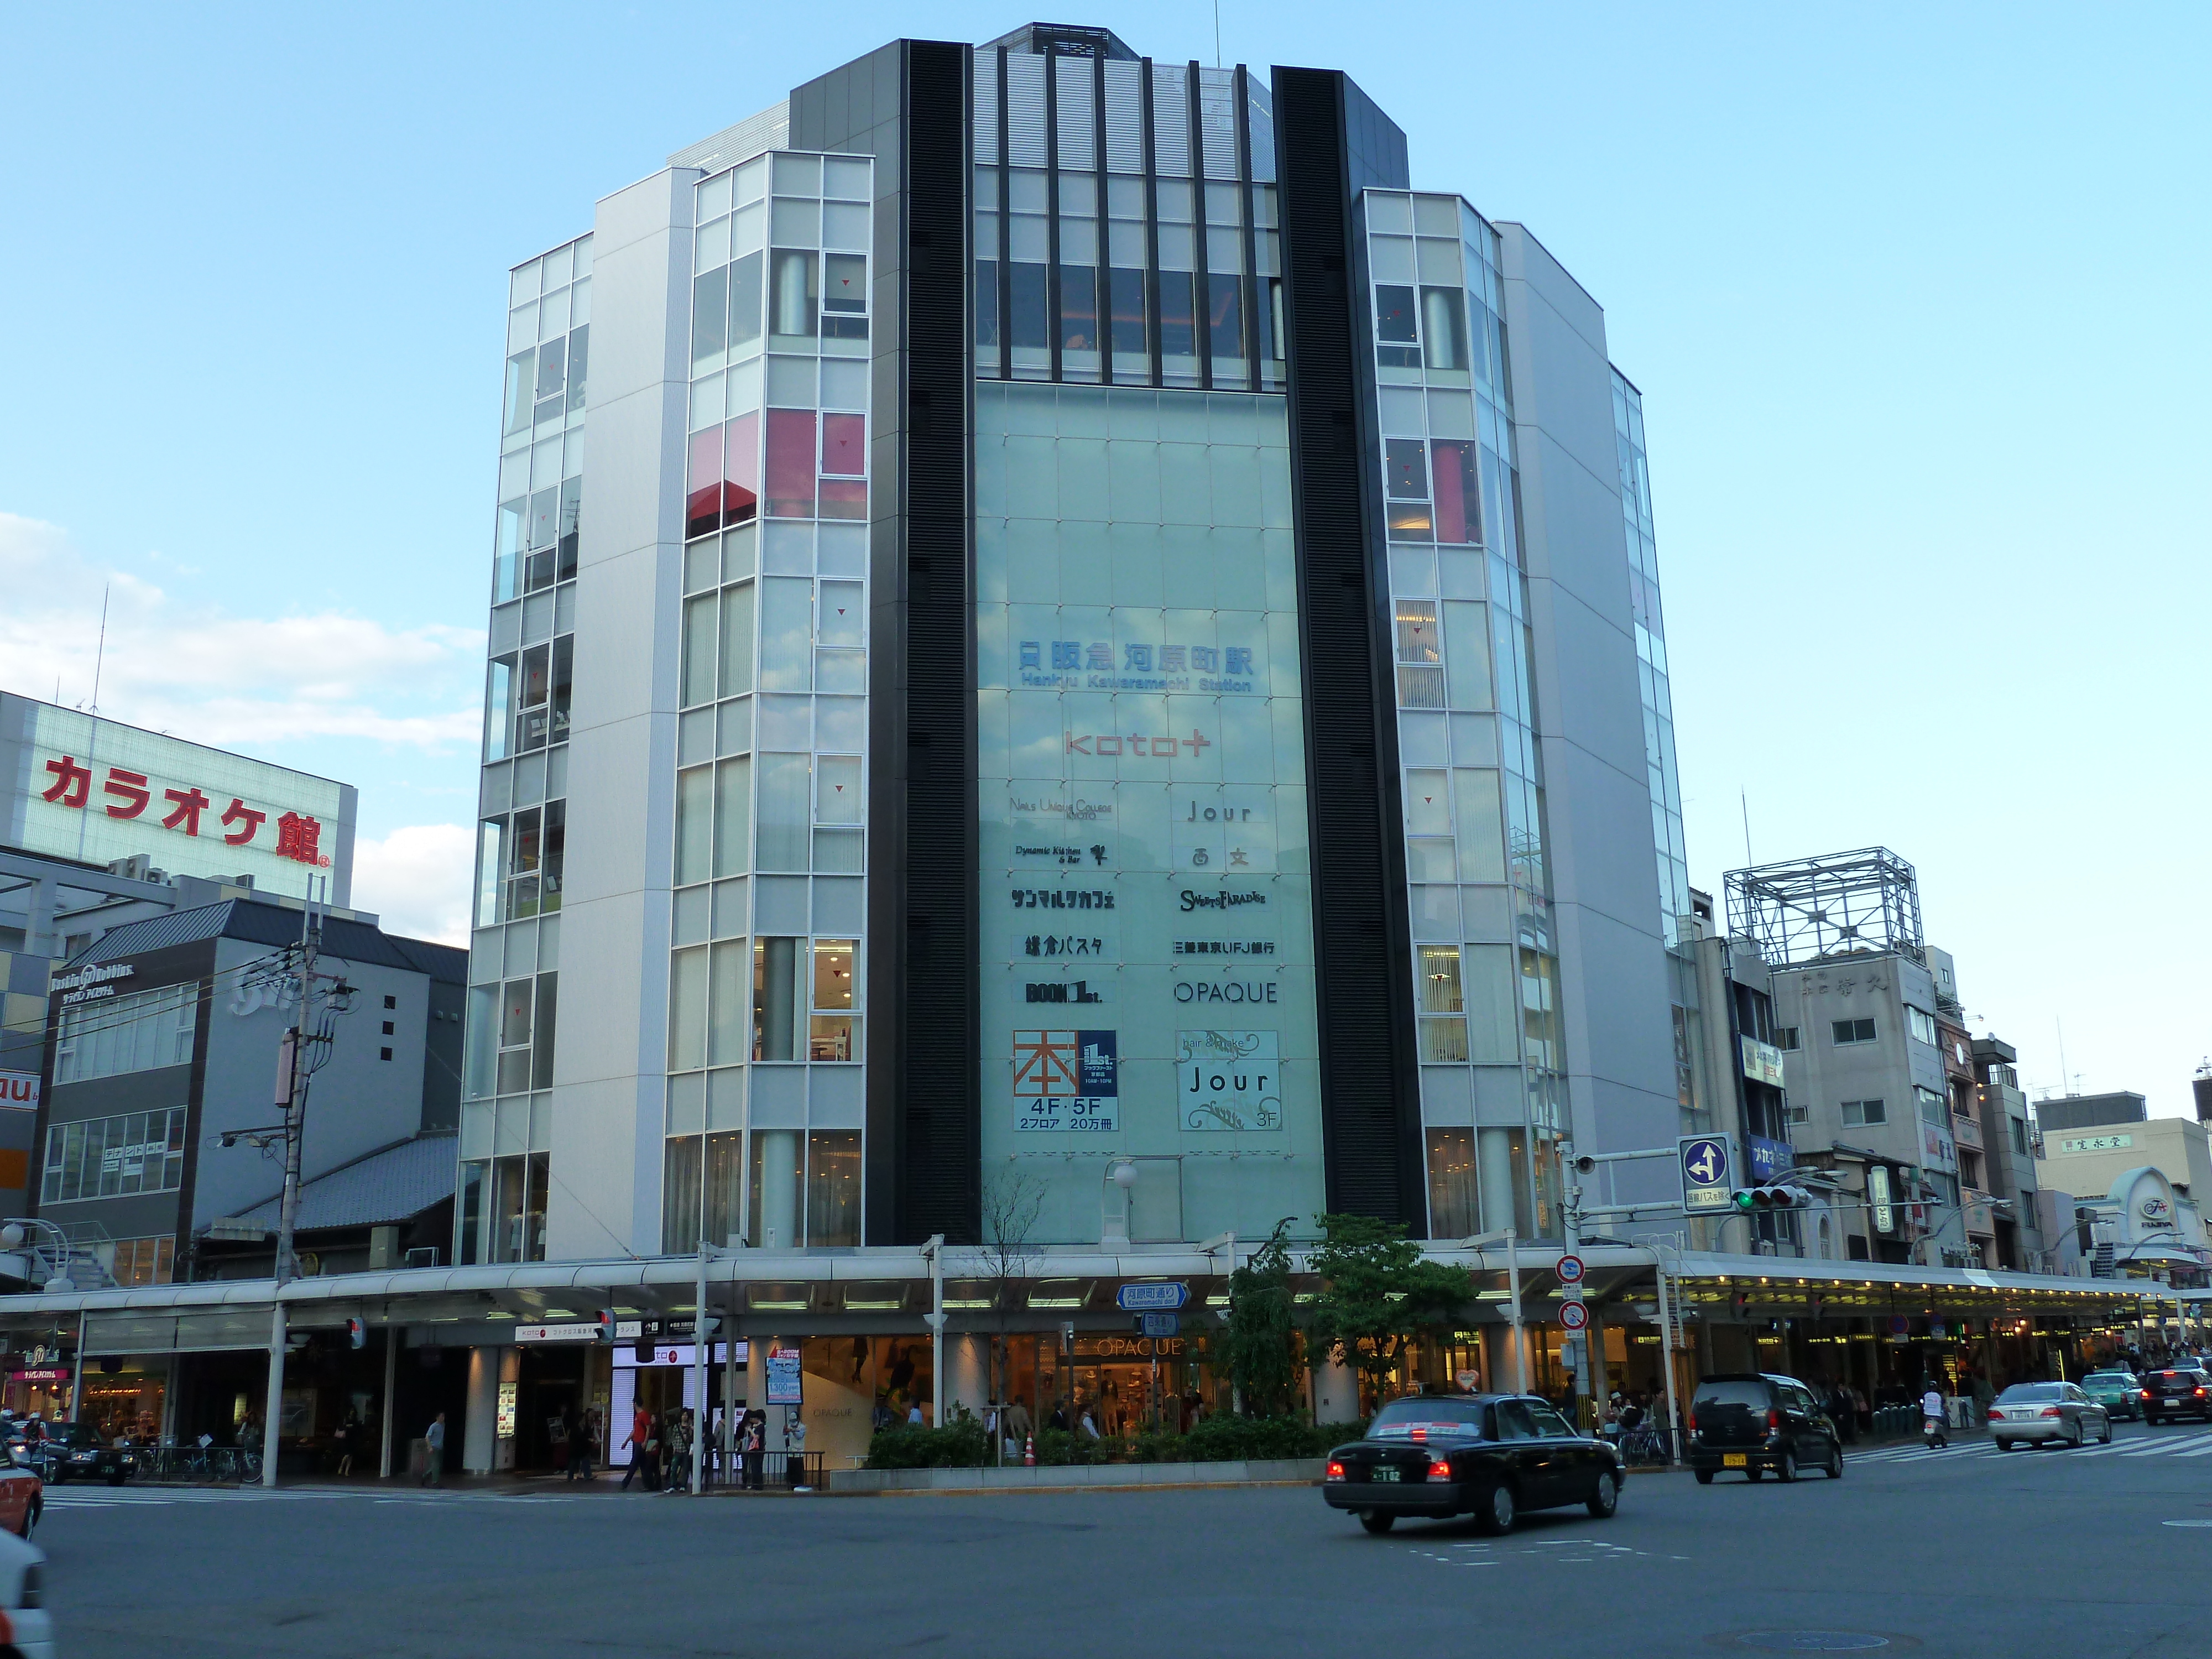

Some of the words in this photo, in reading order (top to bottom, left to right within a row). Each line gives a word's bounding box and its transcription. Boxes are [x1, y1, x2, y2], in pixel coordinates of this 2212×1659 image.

[1052, 641, 1253, 674] 阪急河原町駅
[1022, 672, 1077, 687] Hankyu
[1087, 674, 1189, 690] Kawaramachi
[1199, 677, 1250, 691] Station
[41, 756, 321, 865] カラオケ館
[1066, 811, 1096, 820] KYOTO
[1188, 801, 1250, 821] Jour
[1016, 846, 1050, 855] Dynamic
[1052, 846, 1081, 855] Kitchen
[1011, 890, 1114, 908] サンマルクカフェ
[1025, 935, 1102, 956] 鎌倉パスタ
[1173, 942, 1275, 954] 三菱東京UFJ銀行
[51, 973, 81, 992] Baskin
[1174, 983, 1277, 1002] OPAQUE
[1183, 1039, 1202, 1047] hair
[1206, 1039, 1213, 1047] &
[1217, 1039, 1244, 1047] make
[1190, 1067, 1267, 1092] Jour
[1020, 1118, 1060, 1129] 2フロア
[1071, 1118, 1112, 1130] 20万冊
[1257, 1113, 1276, 1126] 3F
[1687, 1191, 1729, 1203] 路線バスを除く
[1127, 1287, 1173, 1299] 河原町通り
